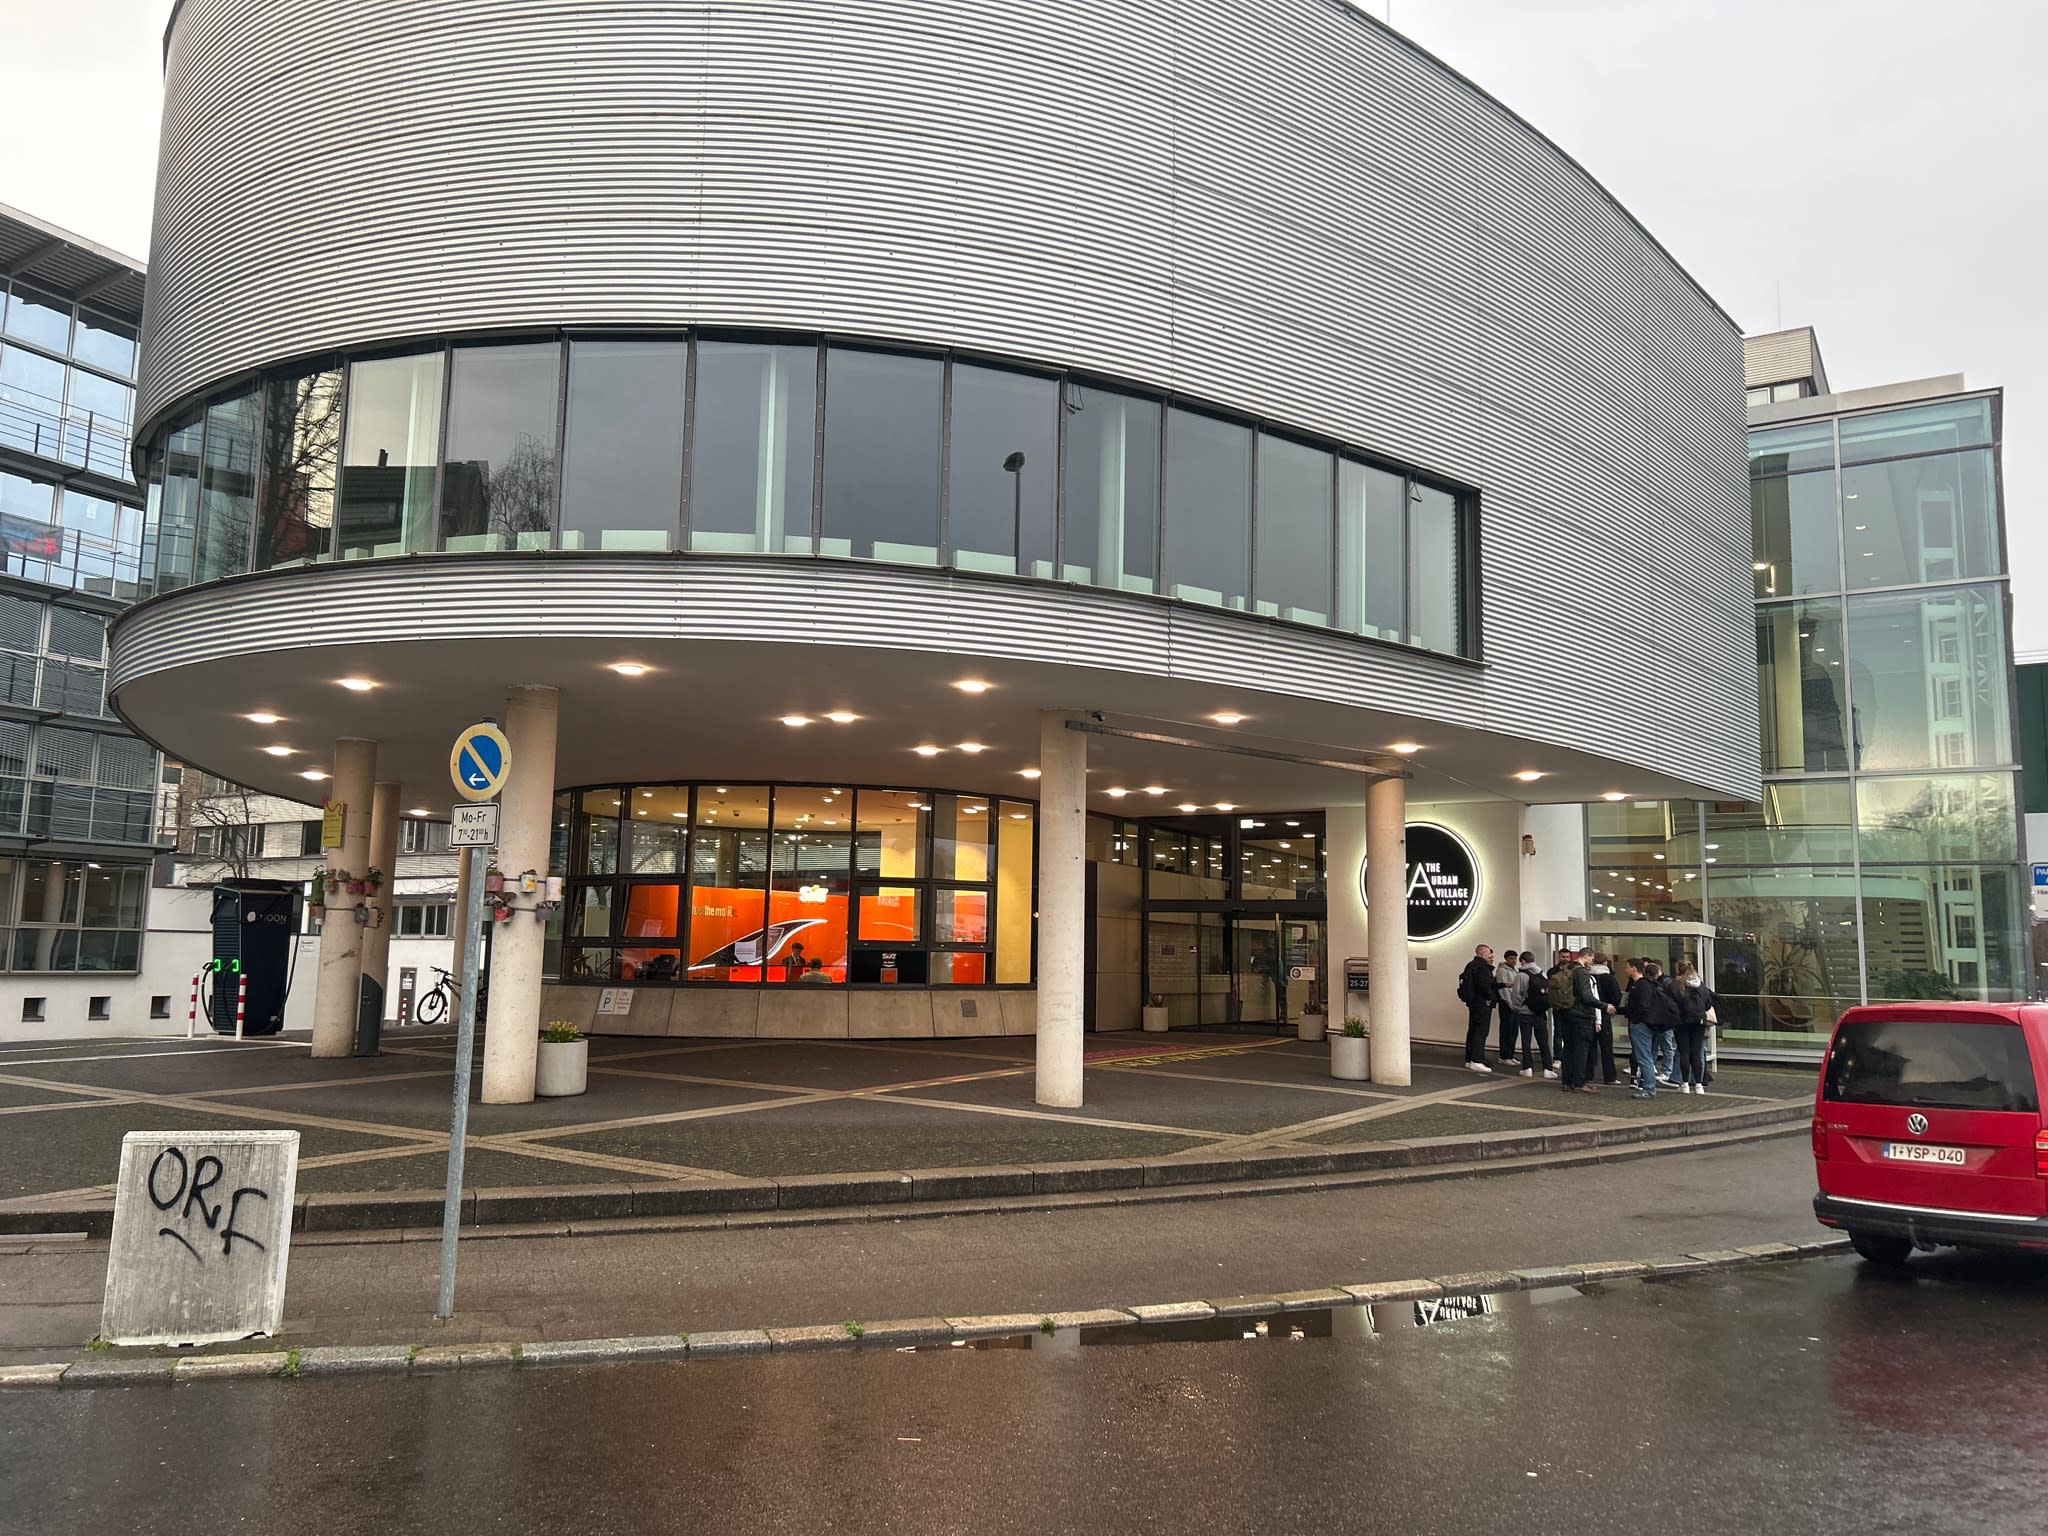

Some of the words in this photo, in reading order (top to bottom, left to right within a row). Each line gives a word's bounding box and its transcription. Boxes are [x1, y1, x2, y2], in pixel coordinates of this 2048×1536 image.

[461, 811, 487, 823] Mo-Fr
[1425, 862, 1441, 873] THE
[1431, 875, 1459, 885] URBAN
[1435, 888, 1469, 898] VILLAGE
[264, 913, 287, 922] OON
